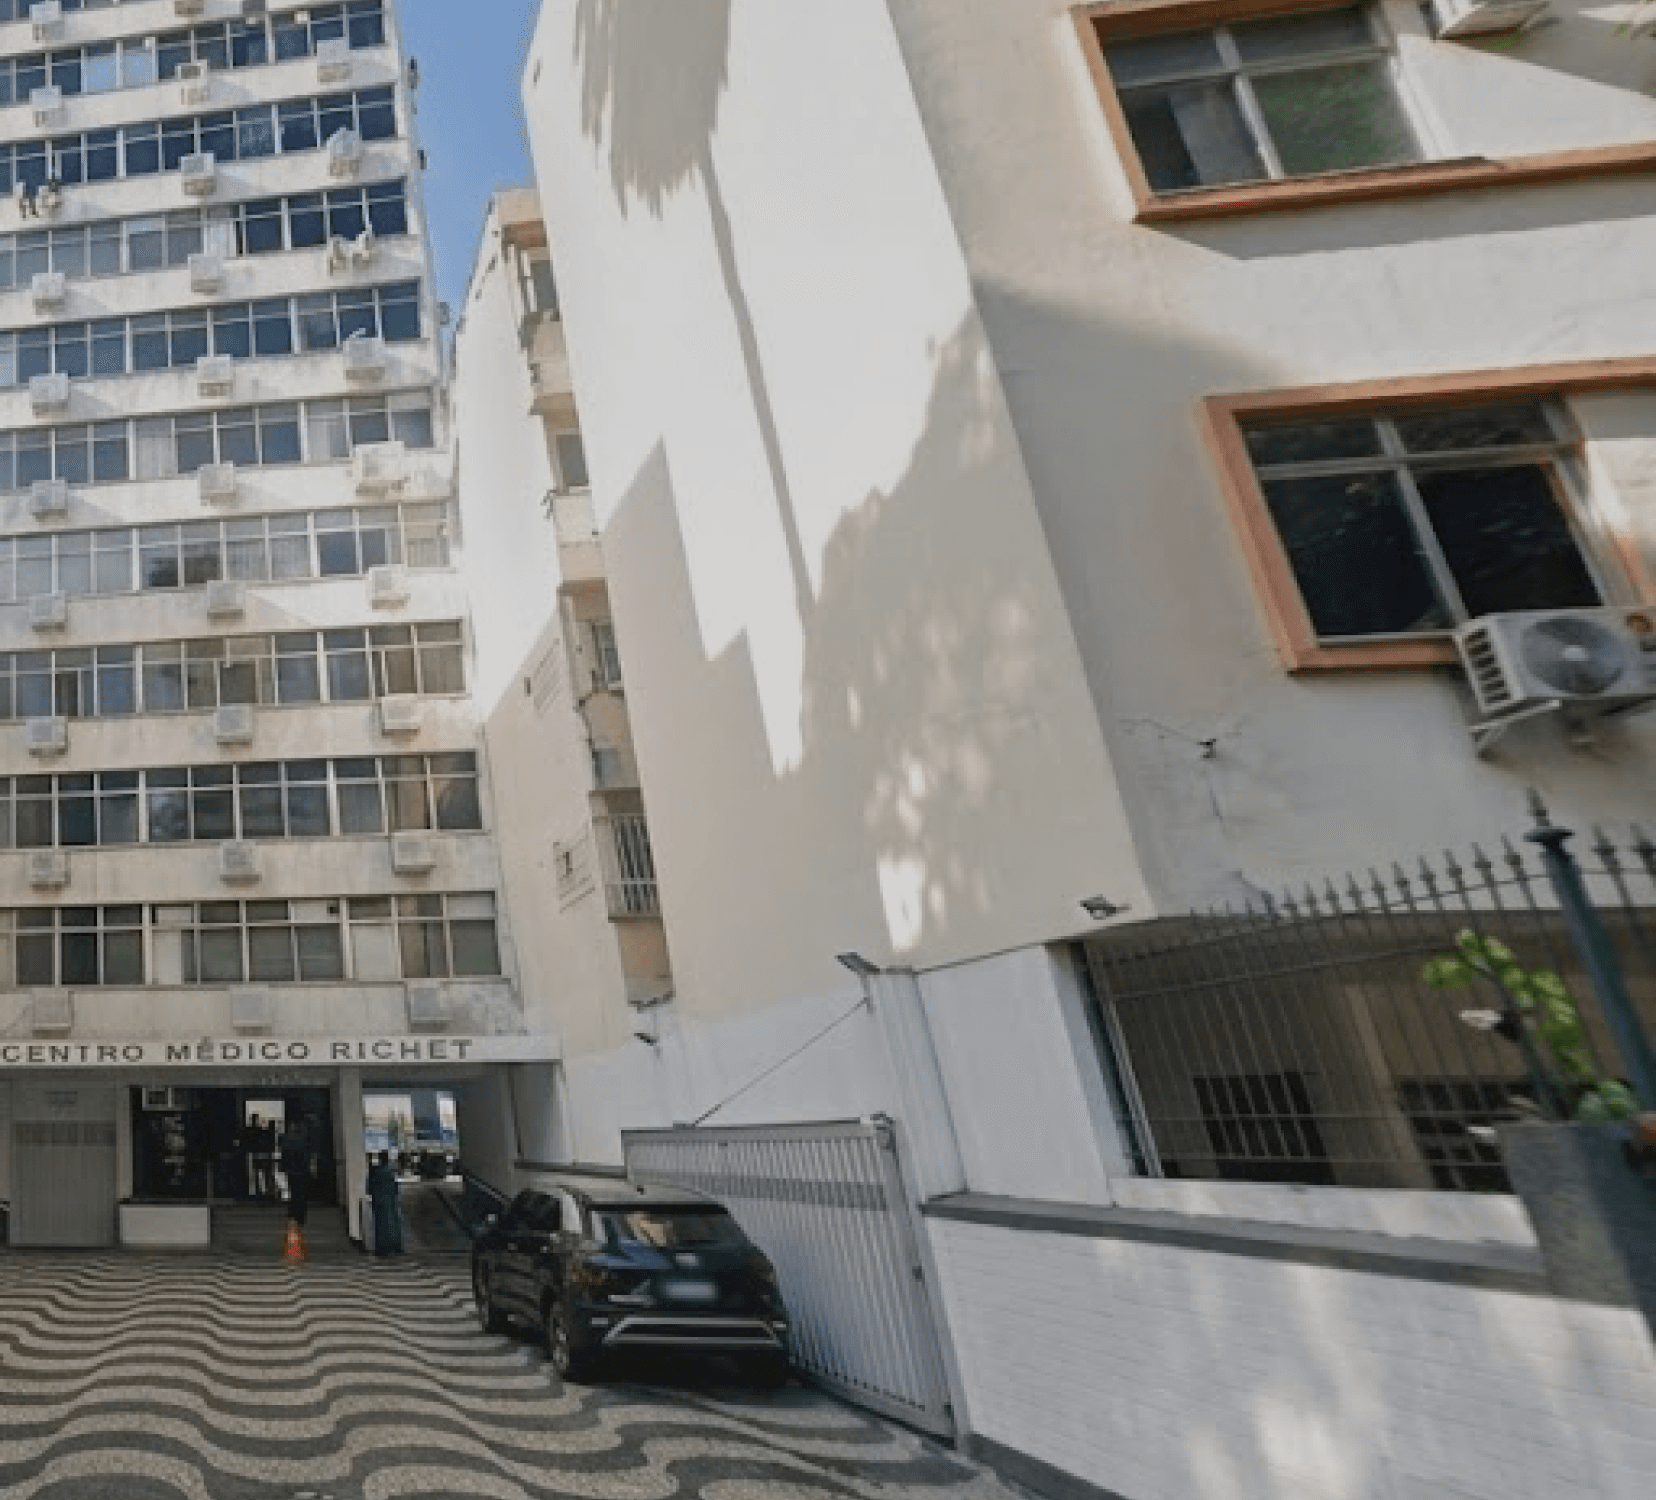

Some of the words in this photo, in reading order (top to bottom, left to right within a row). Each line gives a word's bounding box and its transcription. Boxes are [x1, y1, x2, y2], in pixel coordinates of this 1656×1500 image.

[1, 1045, 143, 1063] CENTRO
[166, 1036, 310, 1062] MÉDICO
[330, 1039, 473, 1061] RICHET
